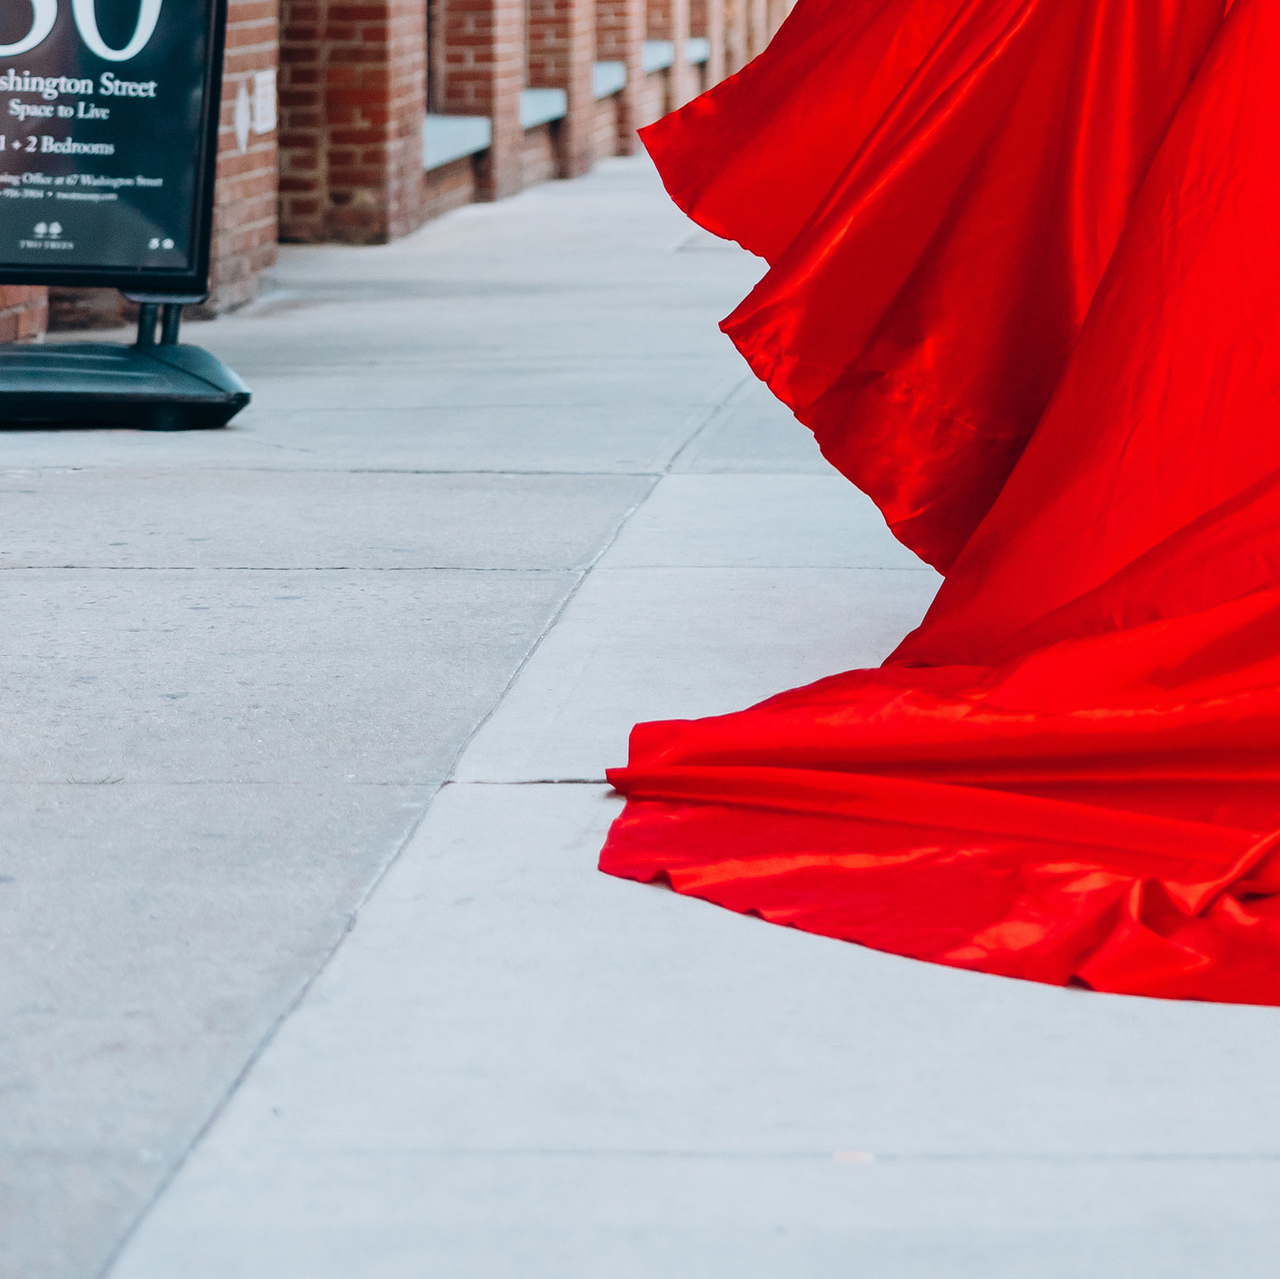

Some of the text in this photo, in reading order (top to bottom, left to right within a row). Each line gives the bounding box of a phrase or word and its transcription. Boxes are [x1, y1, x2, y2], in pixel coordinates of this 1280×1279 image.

[100, 72, 157, 98] Street
[9, 98, 110, 121] Space to Live
[25, 135, 38, 153] 2
[40, 135, 115, 155] Bedrooms
